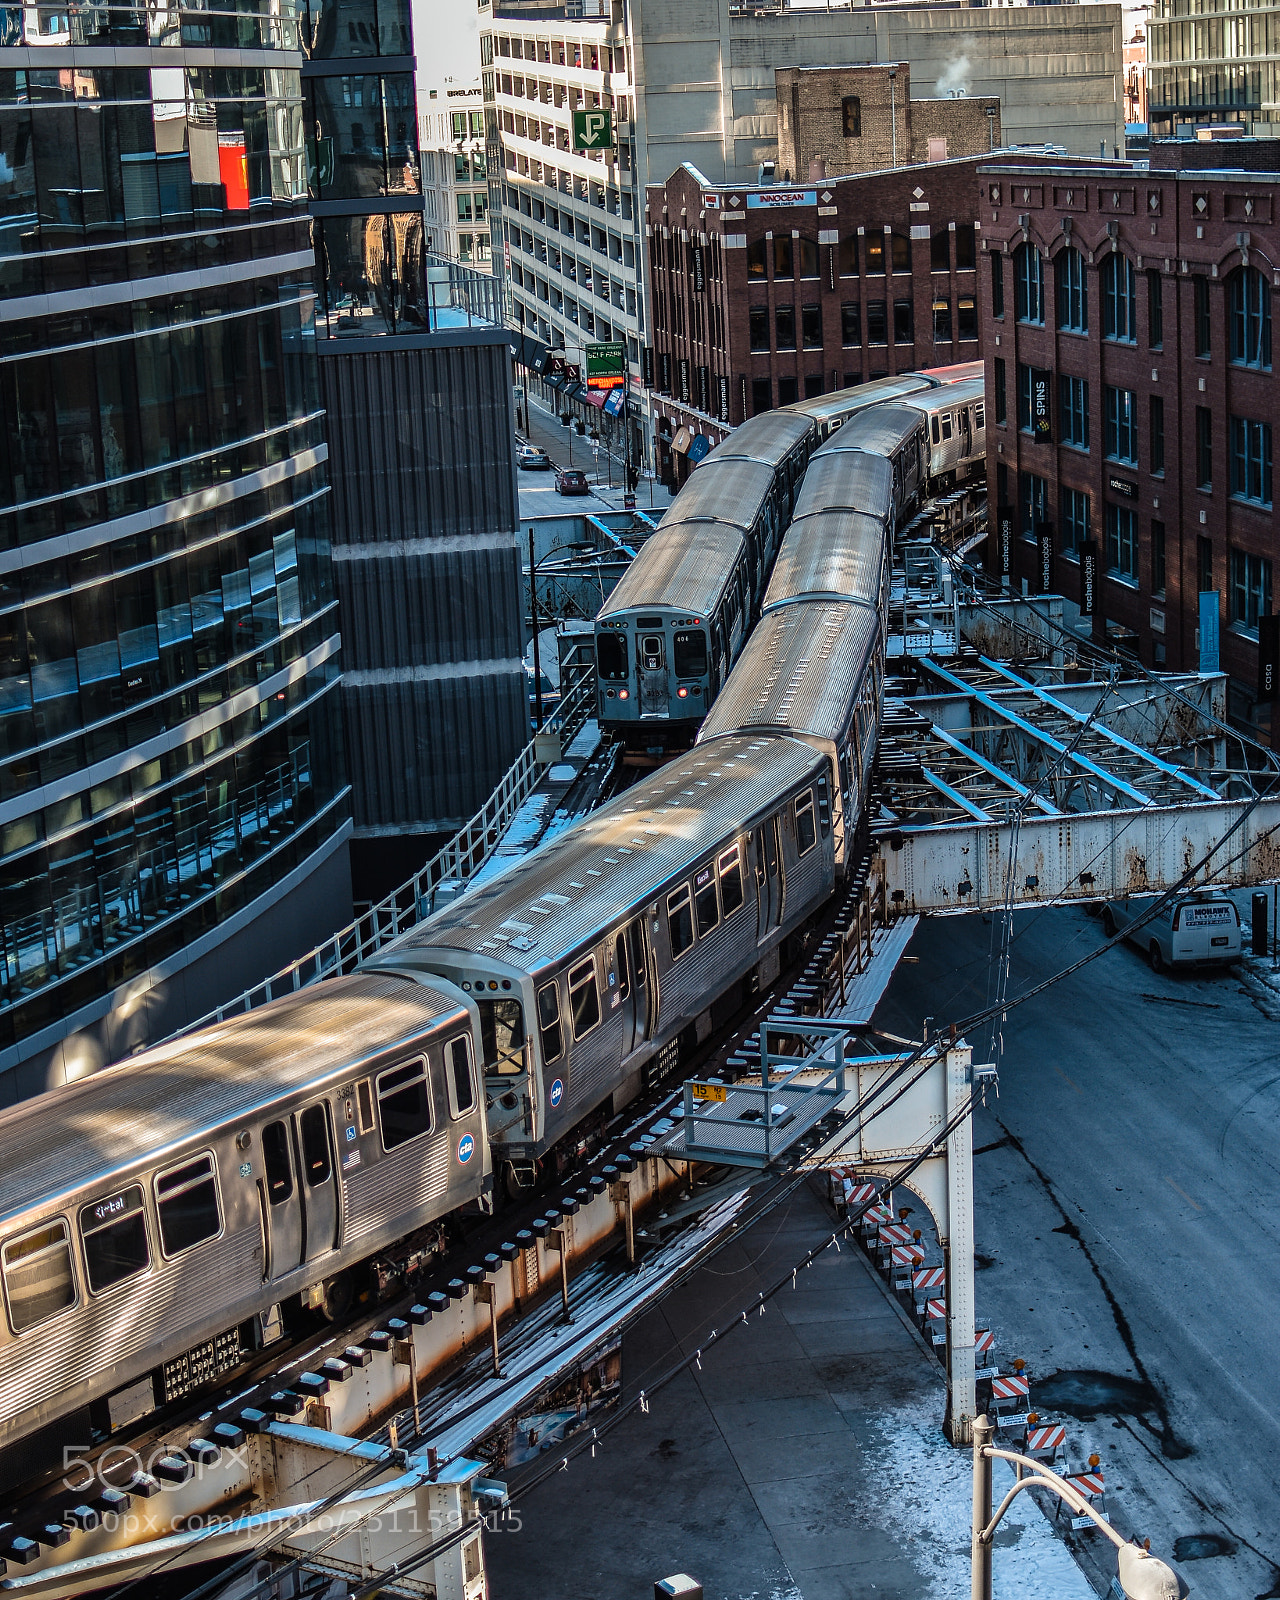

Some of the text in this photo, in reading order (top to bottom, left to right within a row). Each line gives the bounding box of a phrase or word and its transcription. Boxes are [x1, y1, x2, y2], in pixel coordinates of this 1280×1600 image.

[760, 193, 804, 202] INNOCEAN
[588, 351, 604, 359] SELF
[681, 361, 689, 401] eggersmann
[720, 378, 729, 420] eggersmann
[1036, 381, 1046, 416] SPINS
[1194, 906, 1230, 916] MOHAWK
[336, 1084, 354, 1100] 3382
[695, 1084, 707, 1095] 15
[459, 1142, 473, 1156] cta
